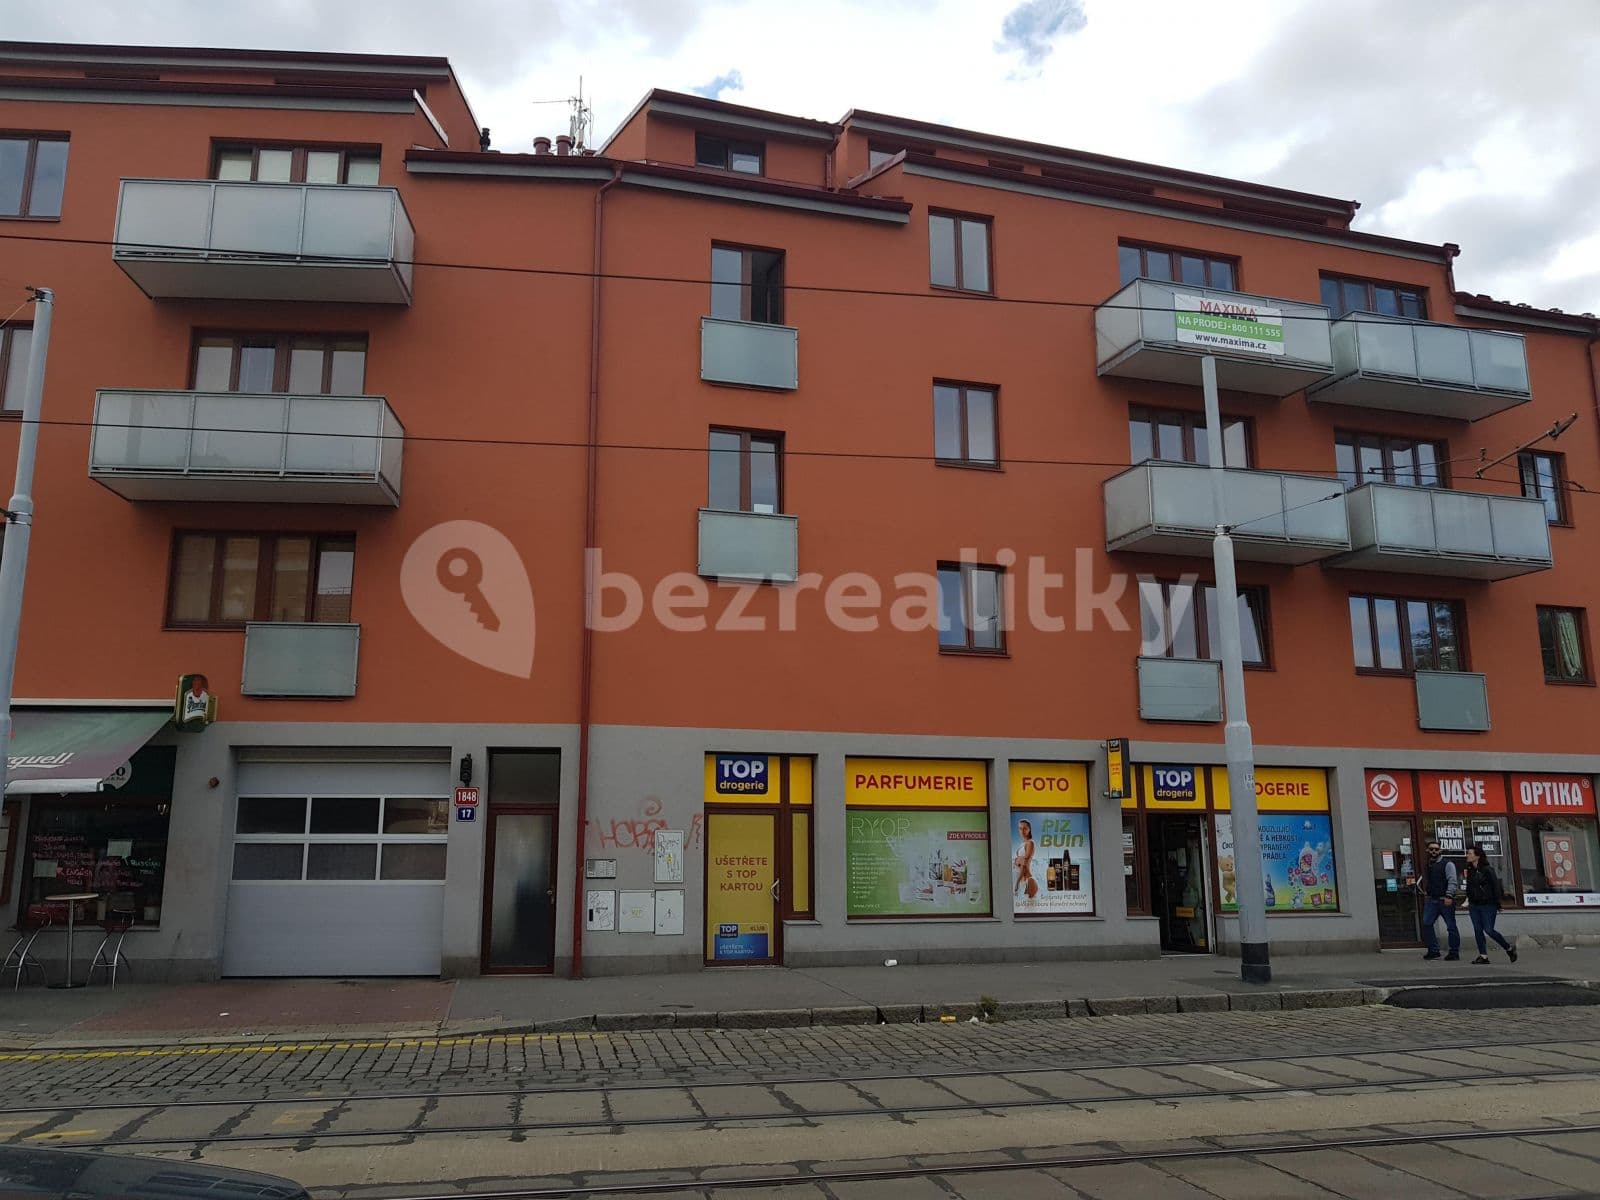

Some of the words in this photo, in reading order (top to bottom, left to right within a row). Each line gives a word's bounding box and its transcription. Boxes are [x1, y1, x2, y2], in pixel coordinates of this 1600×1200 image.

[1199, 300, 1257, 318] MAXIMA
[1177, 315, 1192, 326] NA
[1193, 318, 1227, 330] PRODEJ
[1232, 323, 1248, 333] 800
[1249, 326, 1264, 335] 111
[1265, 328, 1281, 338] 555
[1195, 333, 1267, 350] www.maxima.cz
[719, 759, 765, 779] TOP
[855, 773, 974, 791] PARFUMERIE
[1022, 776, 1070, 792] FOTO
[1155, 769, 1193, 787] TOP
[719, 780, 765, 792] drogerie
[1255, 782, 1310, 796] OGERIE
[1439, 777, 1487, 805] VAŠE
[1519, 780, 1584, 807] OPTIKA
[457, 791, 477, 802] 1848
[1156, 787, 1193, 799] drogerie
[460, 809, 472, 819] 17
[1041, 818, 1072, 833] PIZ
[1437, 825, 1463, 838] MĚŘENÍ
[1439, 838, 1463, 850] ZRAKU
[715, 854, 768, 866] UŠETŘETE
[726, 869, 733, 879] S
[736, 869, 757, 879] TOP
[720, 882, 763, 892] KARTOU
[720, 925, 737, 933] TOP
